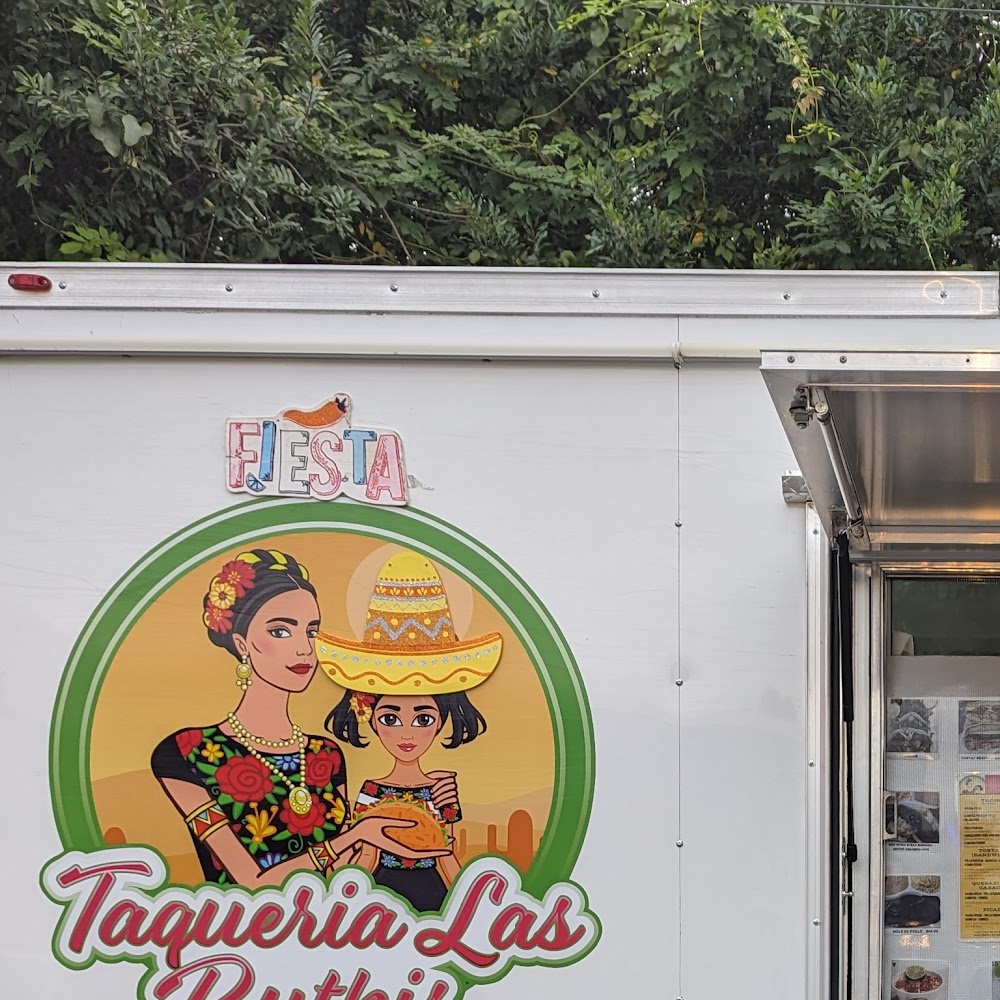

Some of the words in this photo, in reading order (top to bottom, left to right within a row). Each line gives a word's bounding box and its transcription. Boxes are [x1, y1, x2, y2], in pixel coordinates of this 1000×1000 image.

[229, 421, 405, 500] FIESTA
[57, 861, 407, 969] Taqueria
[413, 872, 585, 967] Las
